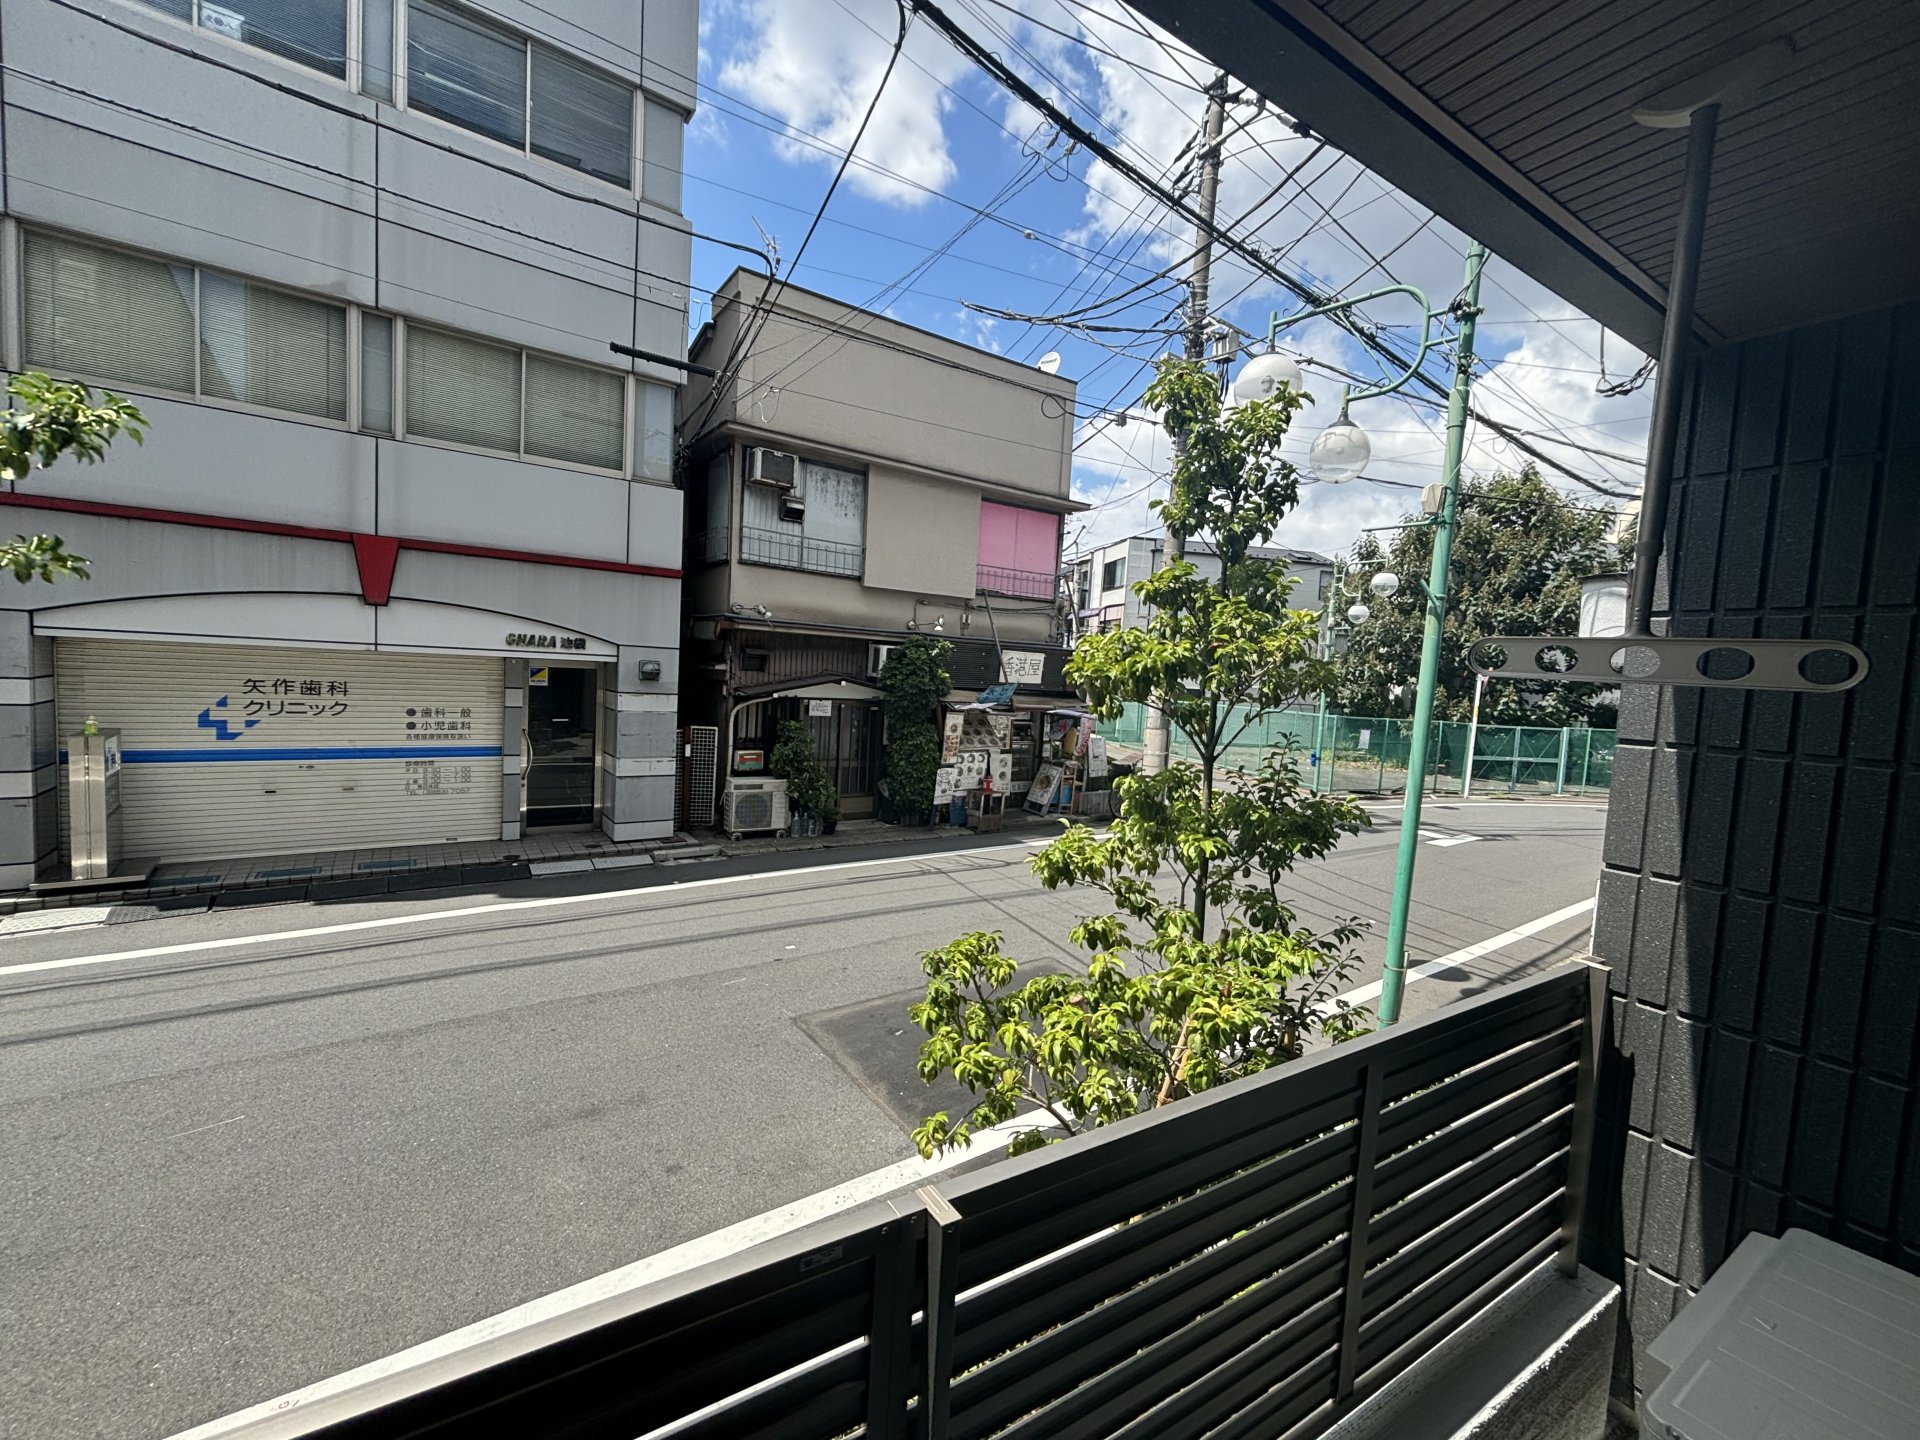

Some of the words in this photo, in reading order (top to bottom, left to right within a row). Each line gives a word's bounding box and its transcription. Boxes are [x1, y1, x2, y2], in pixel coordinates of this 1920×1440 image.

[1002, 656, 1041, 677] 香港屋
[242, 678, 349, 696] 矢作歯科
[243, 700, 348, 716] クリニック
[421, 708, 472, 717] 歯科一般
[421, 721, 471, 730] 小児歯科
